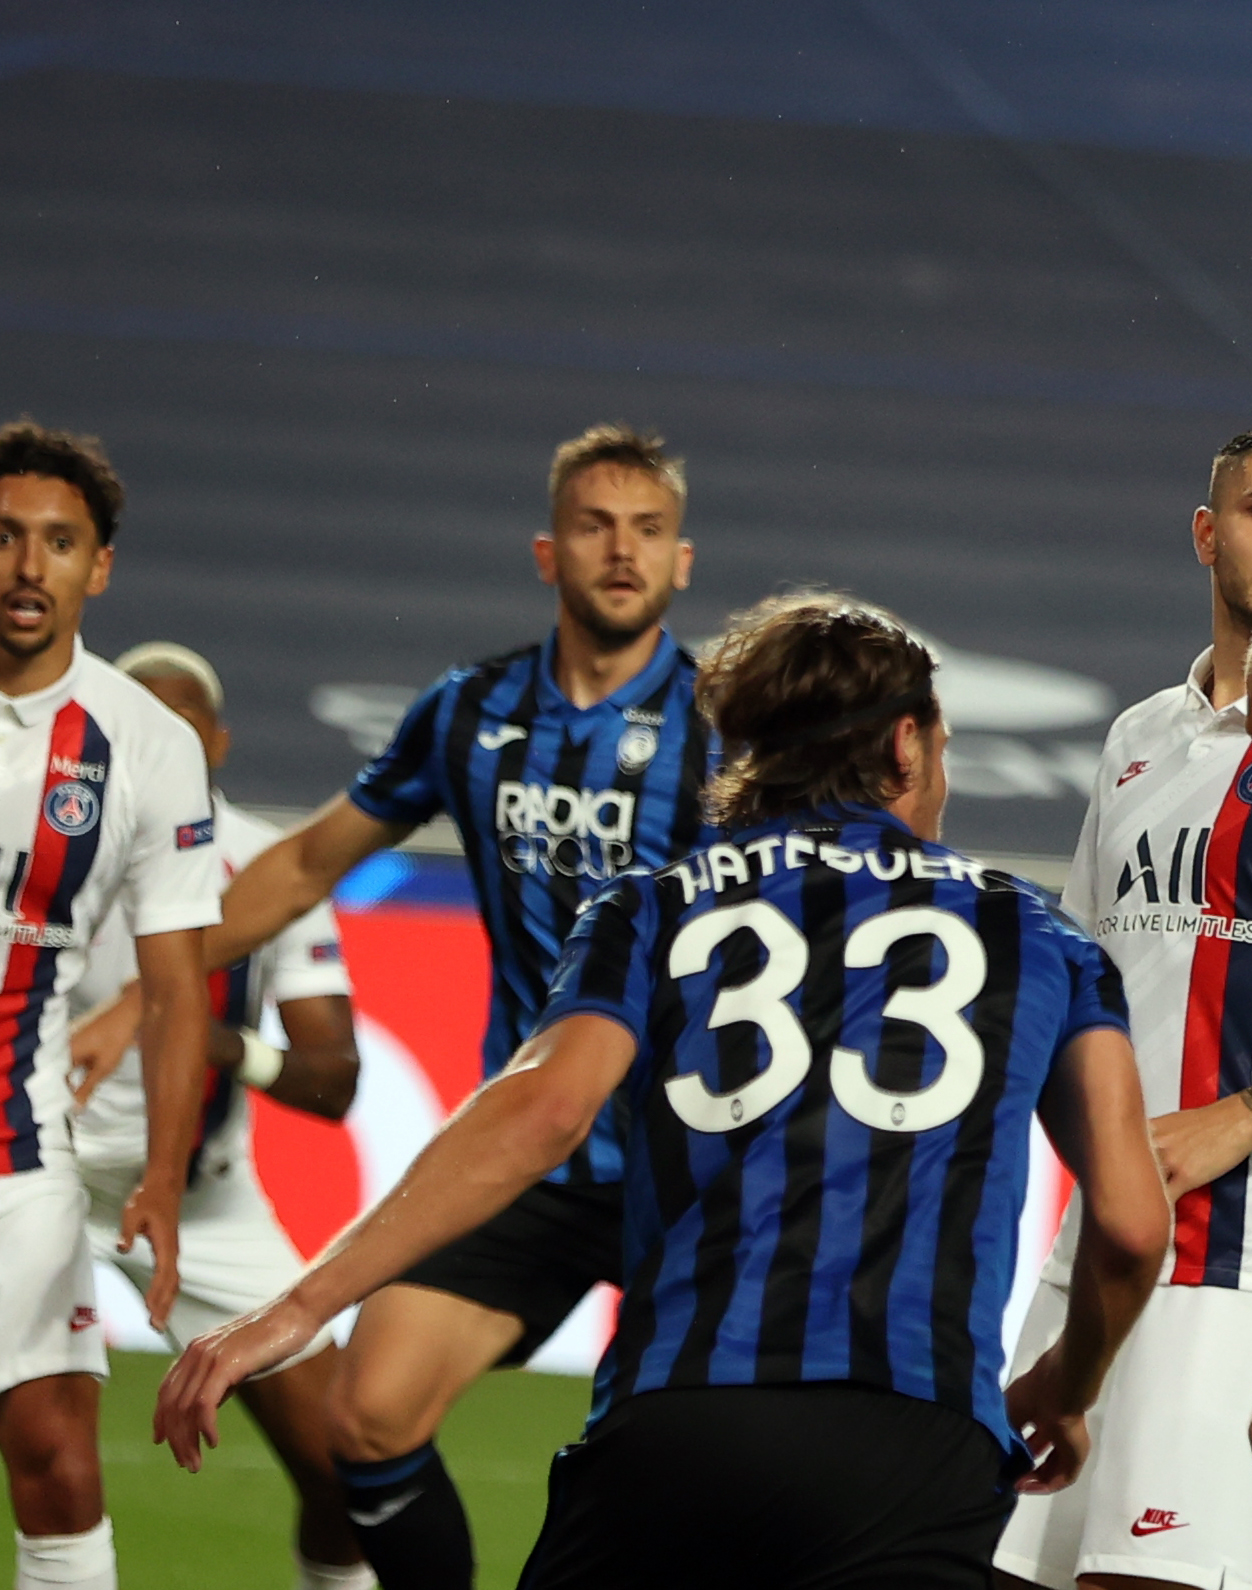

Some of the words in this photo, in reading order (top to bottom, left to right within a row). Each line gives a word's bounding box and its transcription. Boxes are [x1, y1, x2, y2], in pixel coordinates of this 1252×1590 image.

[495, 779, 637, 843] RADICI
[500, 831, 634, 881] GROUP
[1122, 914, 1161, 932] LIVE
[664, 899, 988, 1134] 33
[1141, 1508, 1179, 1527] NIKE
